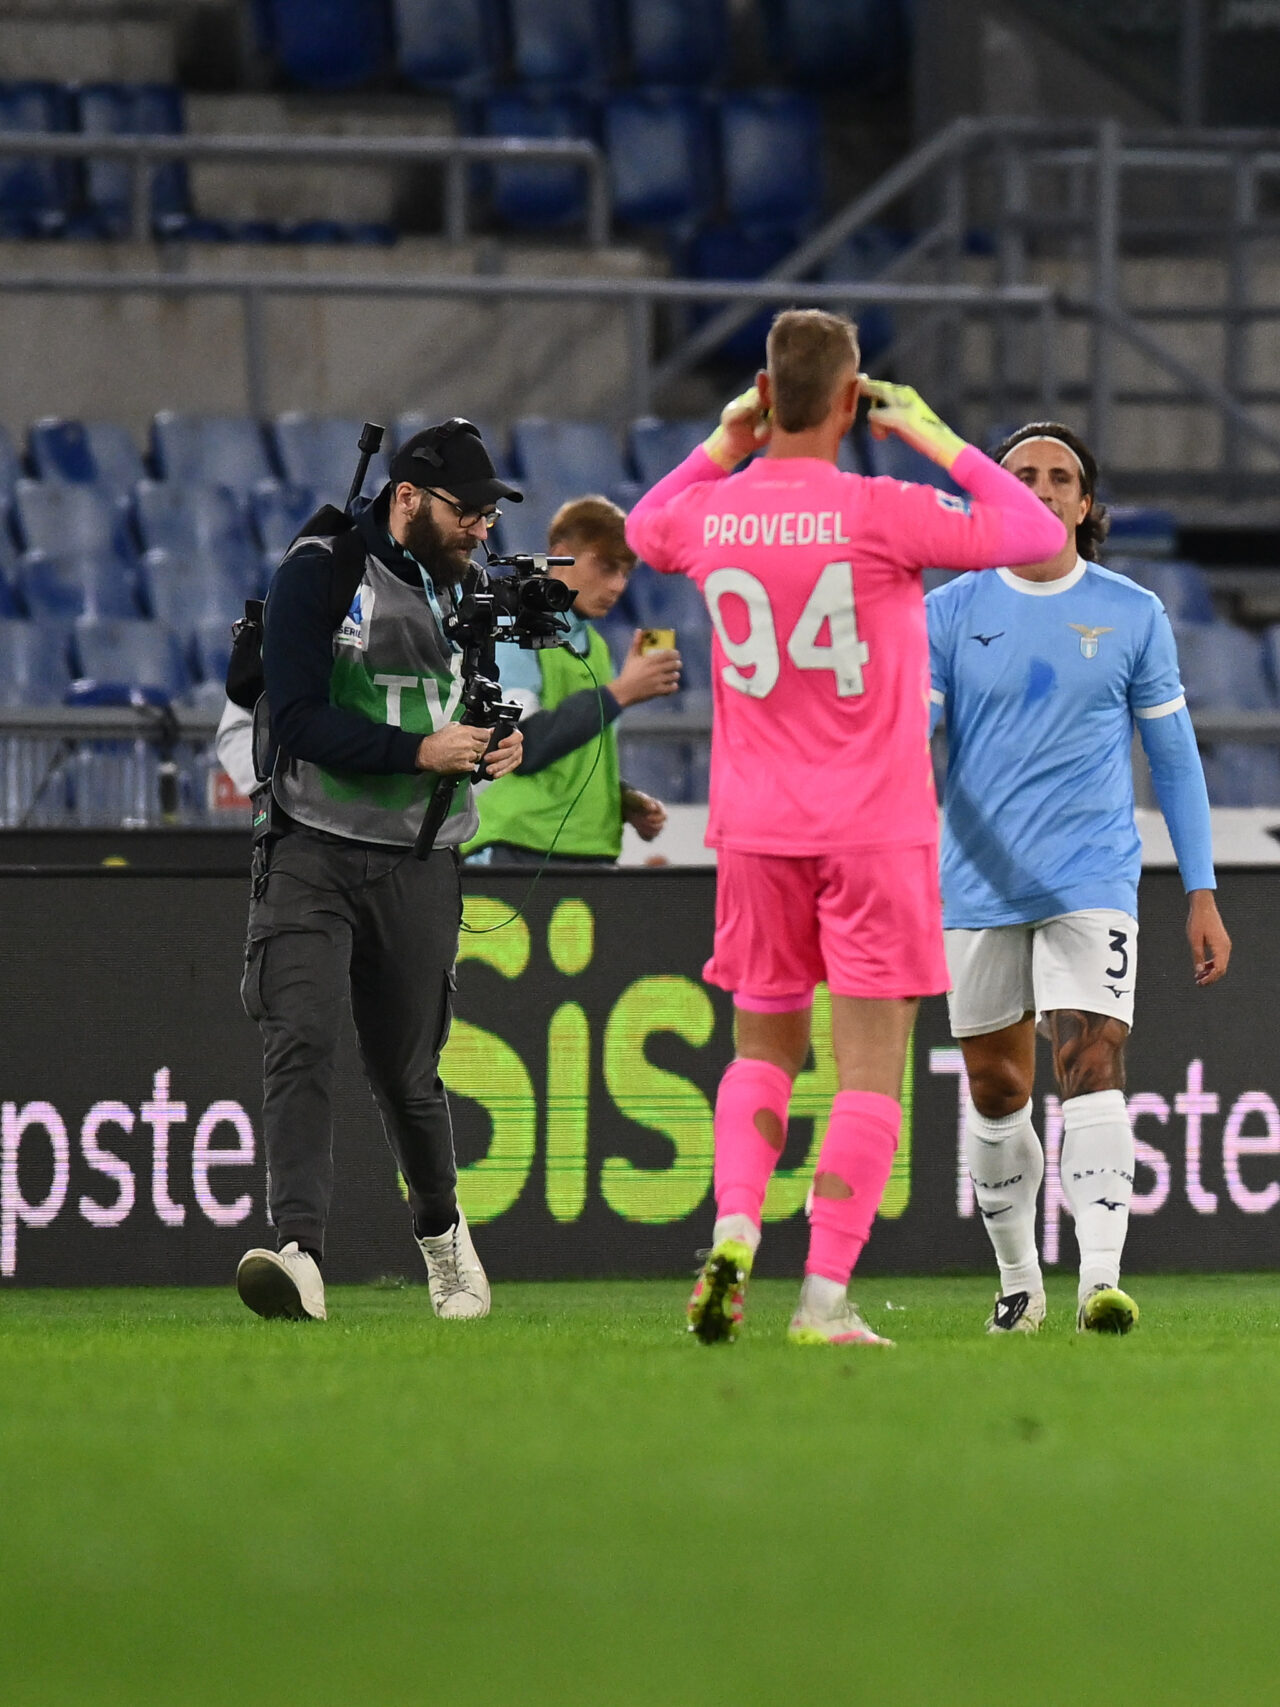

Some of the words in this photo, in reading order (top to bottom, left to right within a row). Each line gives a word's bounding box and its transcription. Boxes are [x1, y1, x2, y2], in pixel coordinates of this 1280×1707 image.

[703, 511, 850, 547] PROVEDEL
[703, 561, 870, 699] 94
[374, 674, 466, 733] TV
[1105, 928, 1128, 979] 3
[397, 895, 915, 1224] Sis
[0, 1066, 275, 1277] pste
